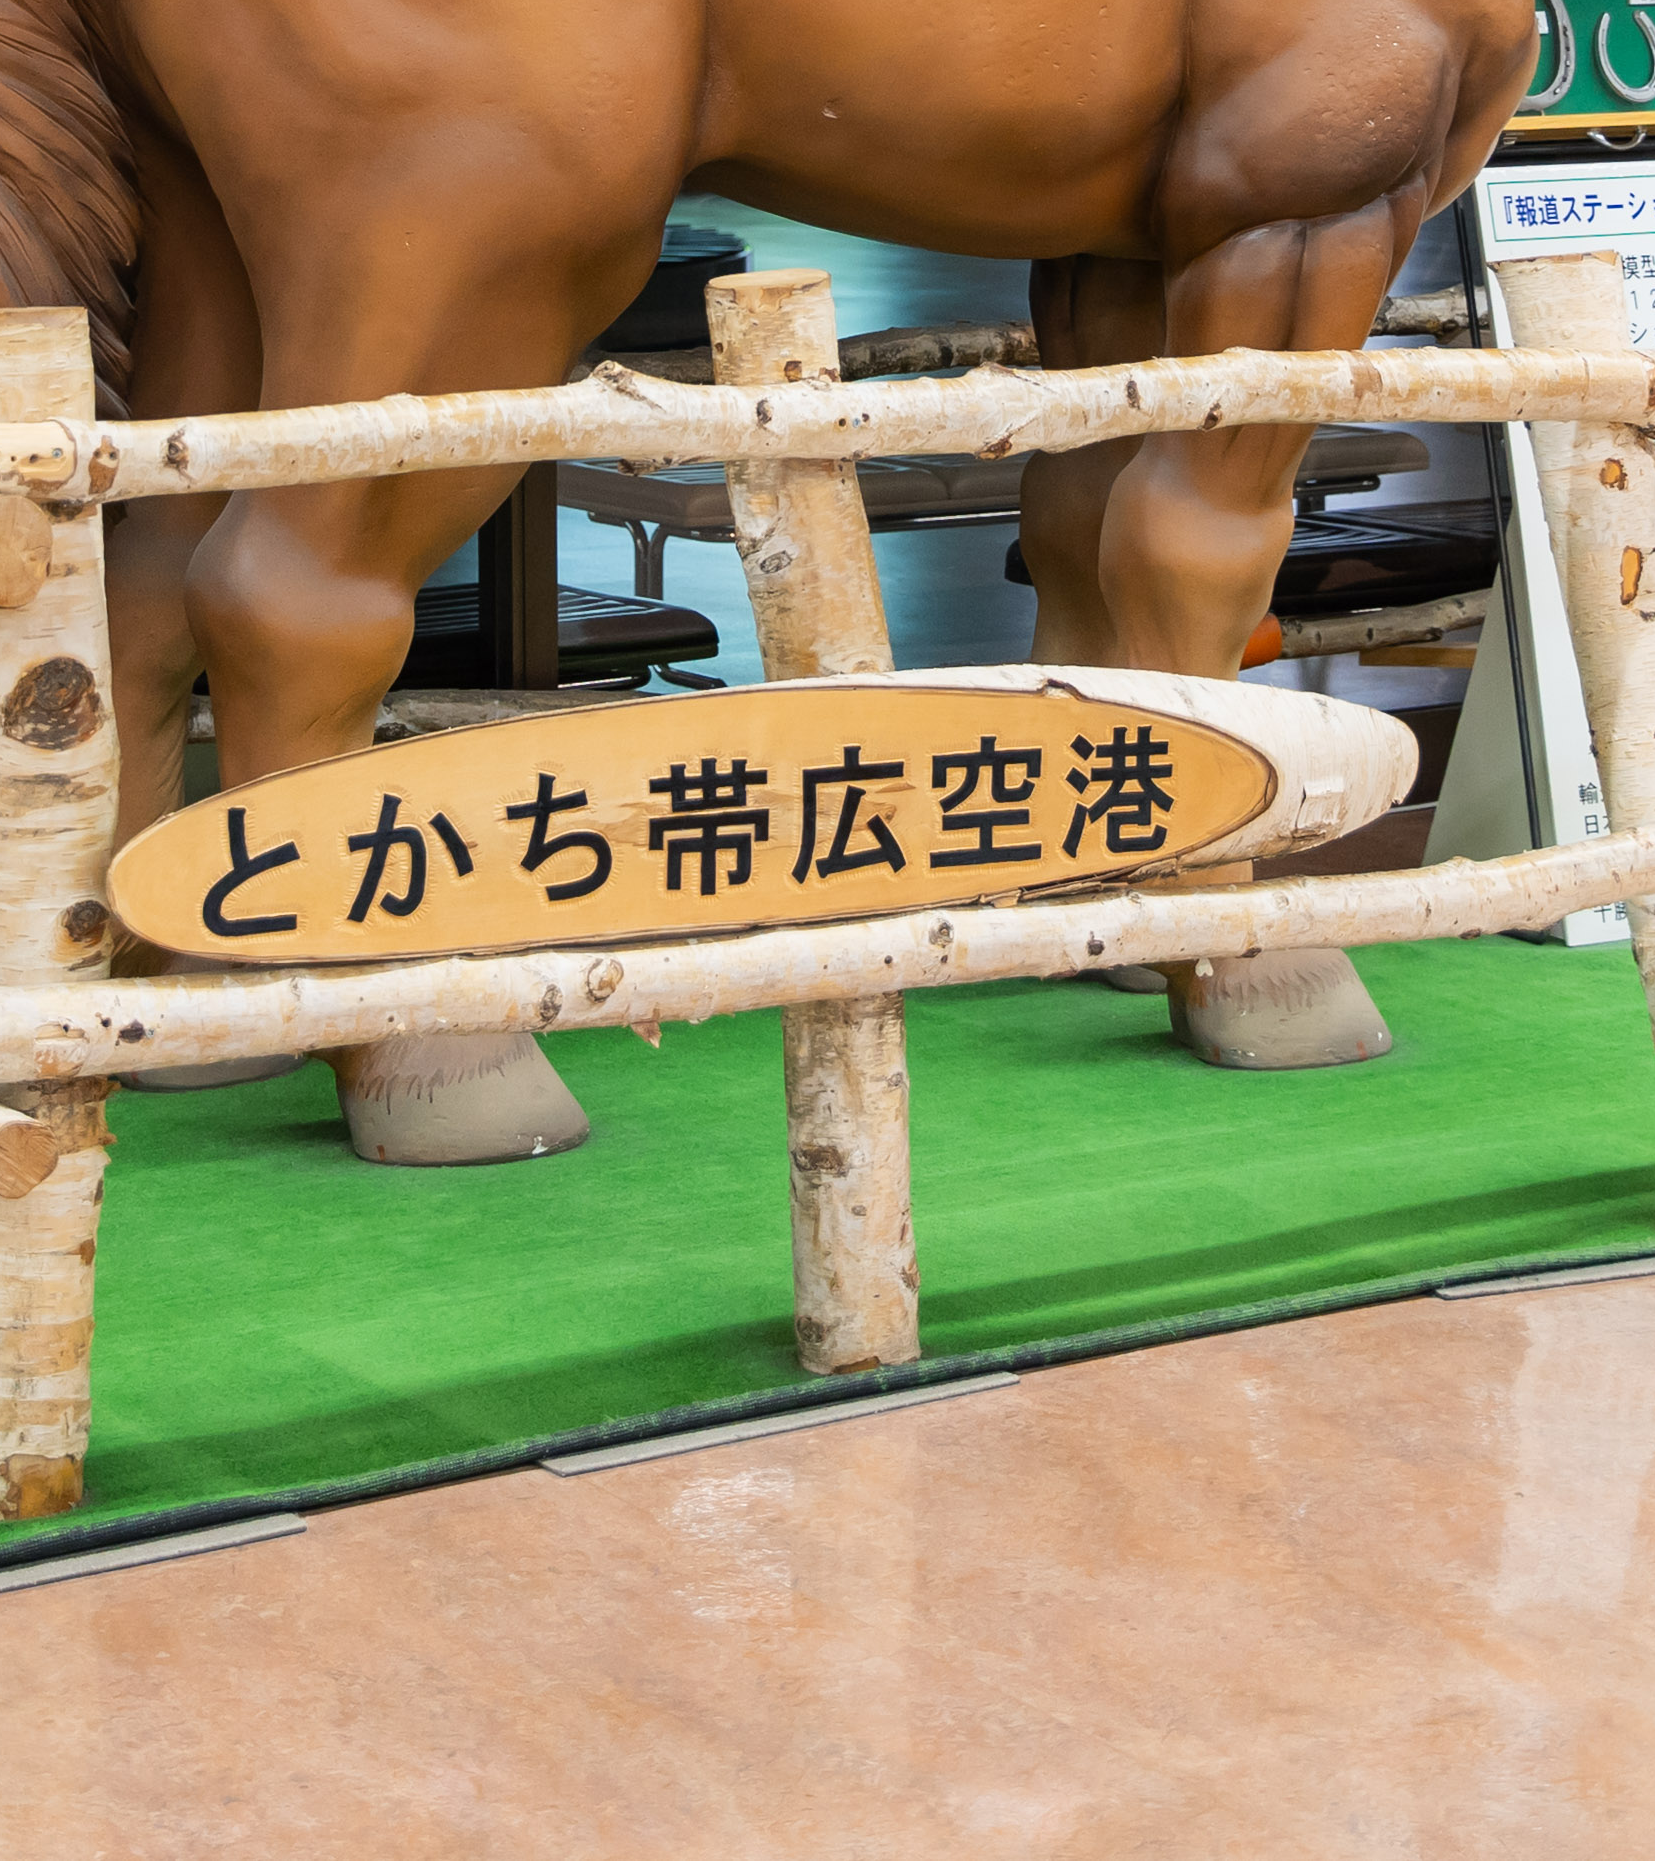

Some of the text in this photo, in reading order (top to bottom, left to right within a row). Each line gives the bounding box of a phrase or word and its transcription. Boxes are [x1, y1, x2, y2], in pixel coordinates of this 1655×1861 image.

[198, 725, 1178, 939] とかち帯広空港
